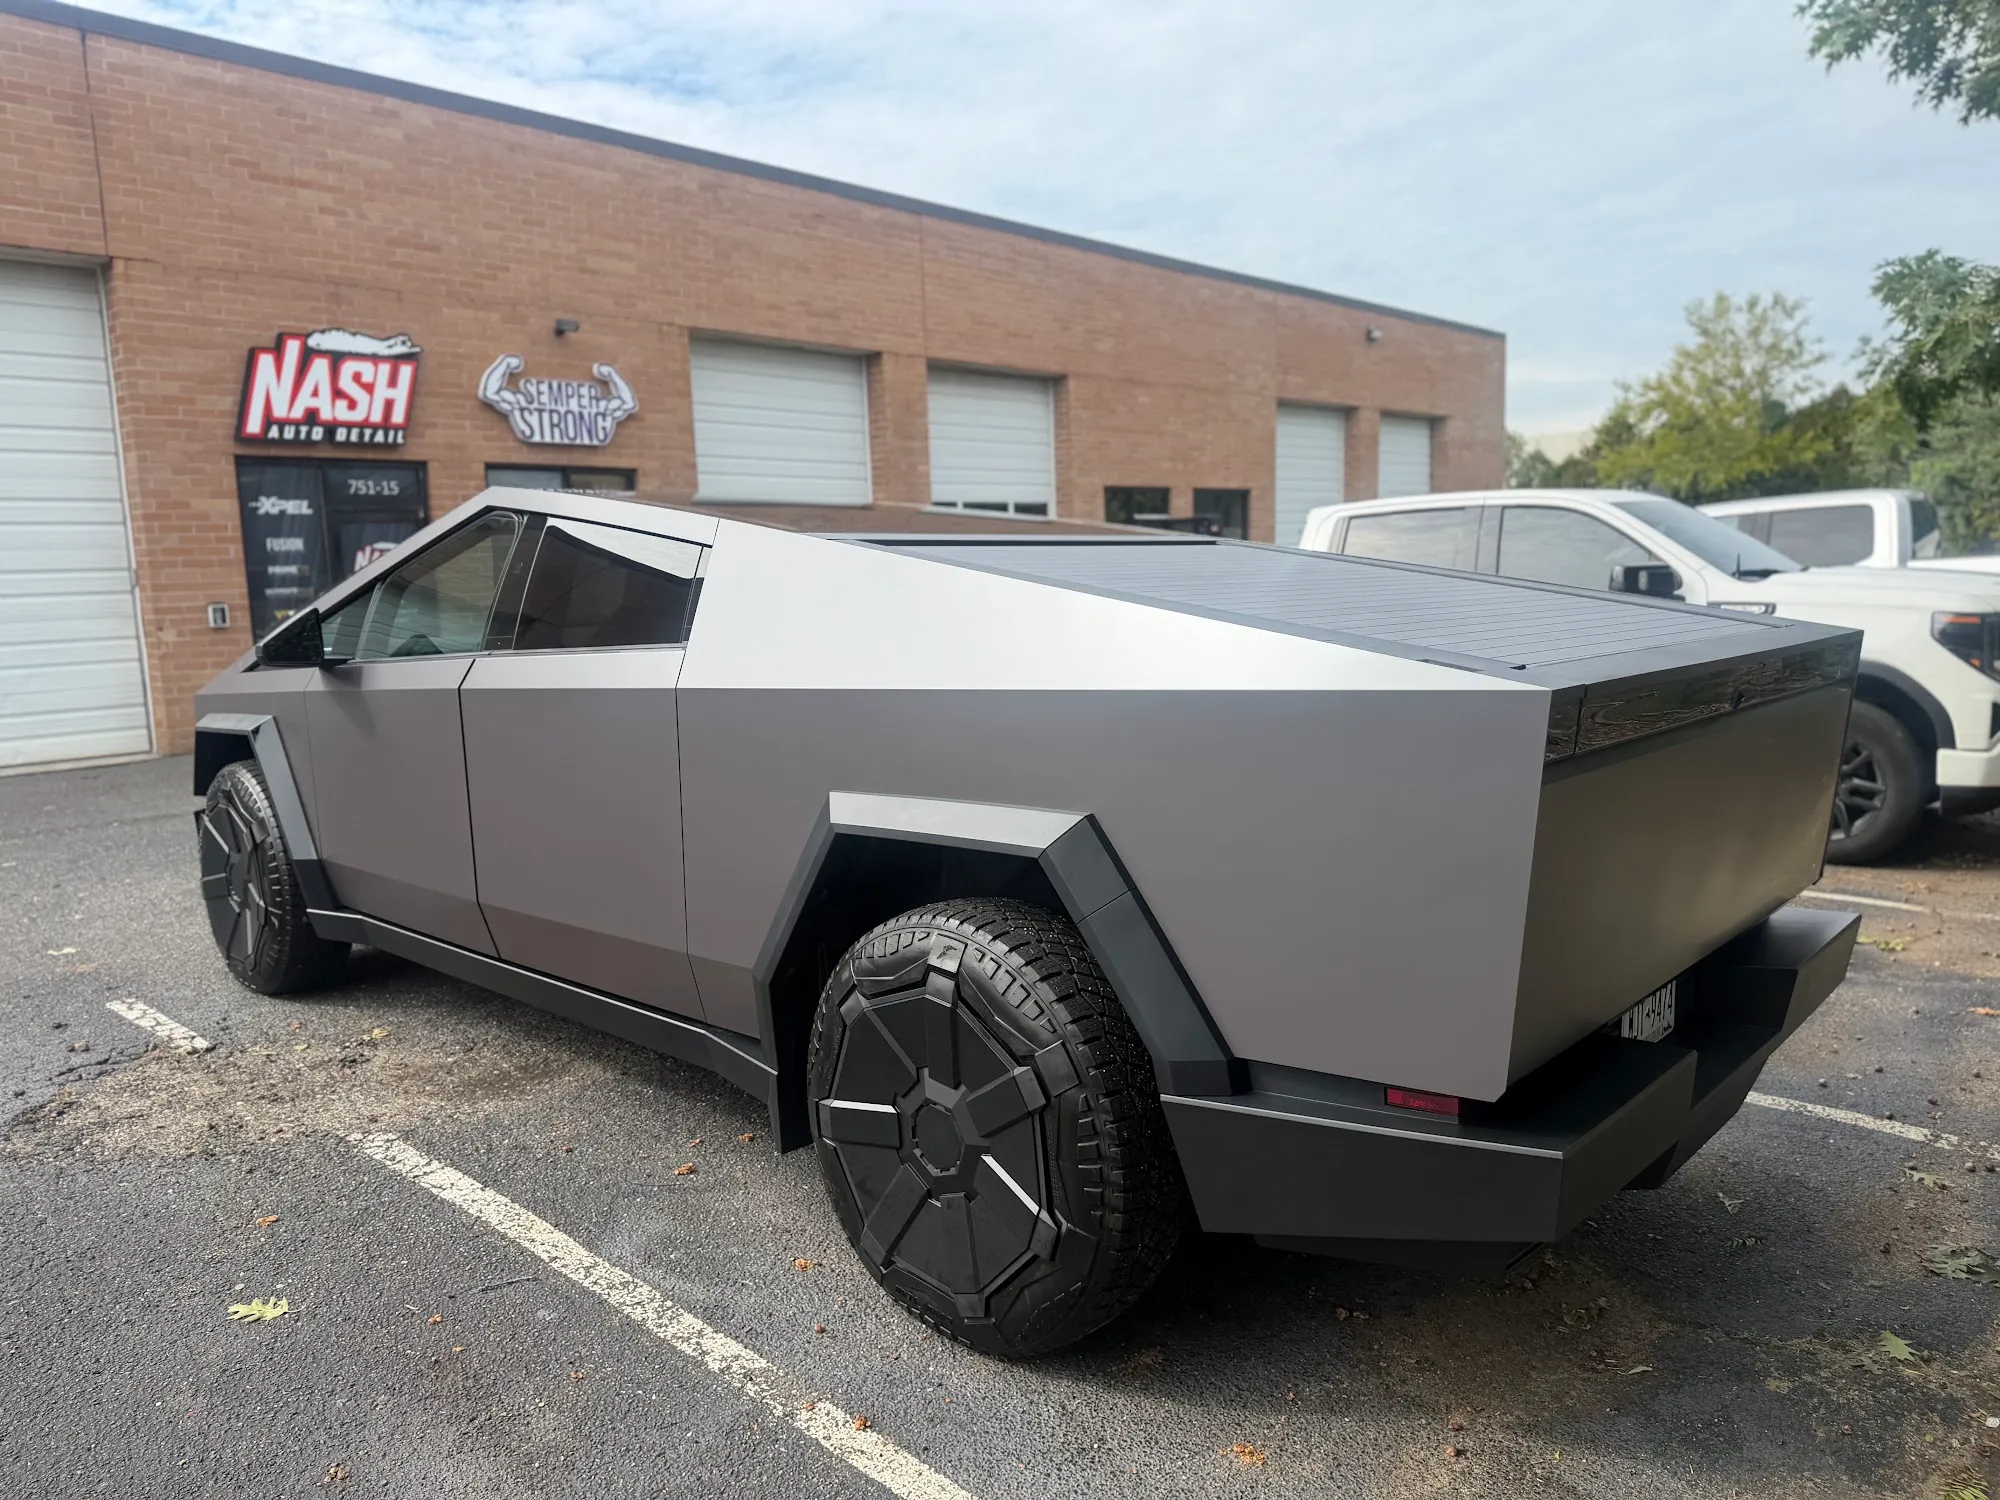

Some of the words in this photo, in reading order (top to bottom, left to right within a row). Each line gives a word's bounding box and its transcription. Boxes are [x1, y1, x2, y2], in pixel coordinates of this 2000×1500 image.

[245, 338, 413, 434] NASH
[523, 379, 599, 409] SEMPER
[267, 424, 324, 440] AUTO
[335, 428, 404, 444] DETAIL
[520, 407, 608, 443] STRONG
[347, 479, 400, 495] 751-15
[250, 496, 313, 515] XPEL
[266, 537, 304, 552] FUSION
